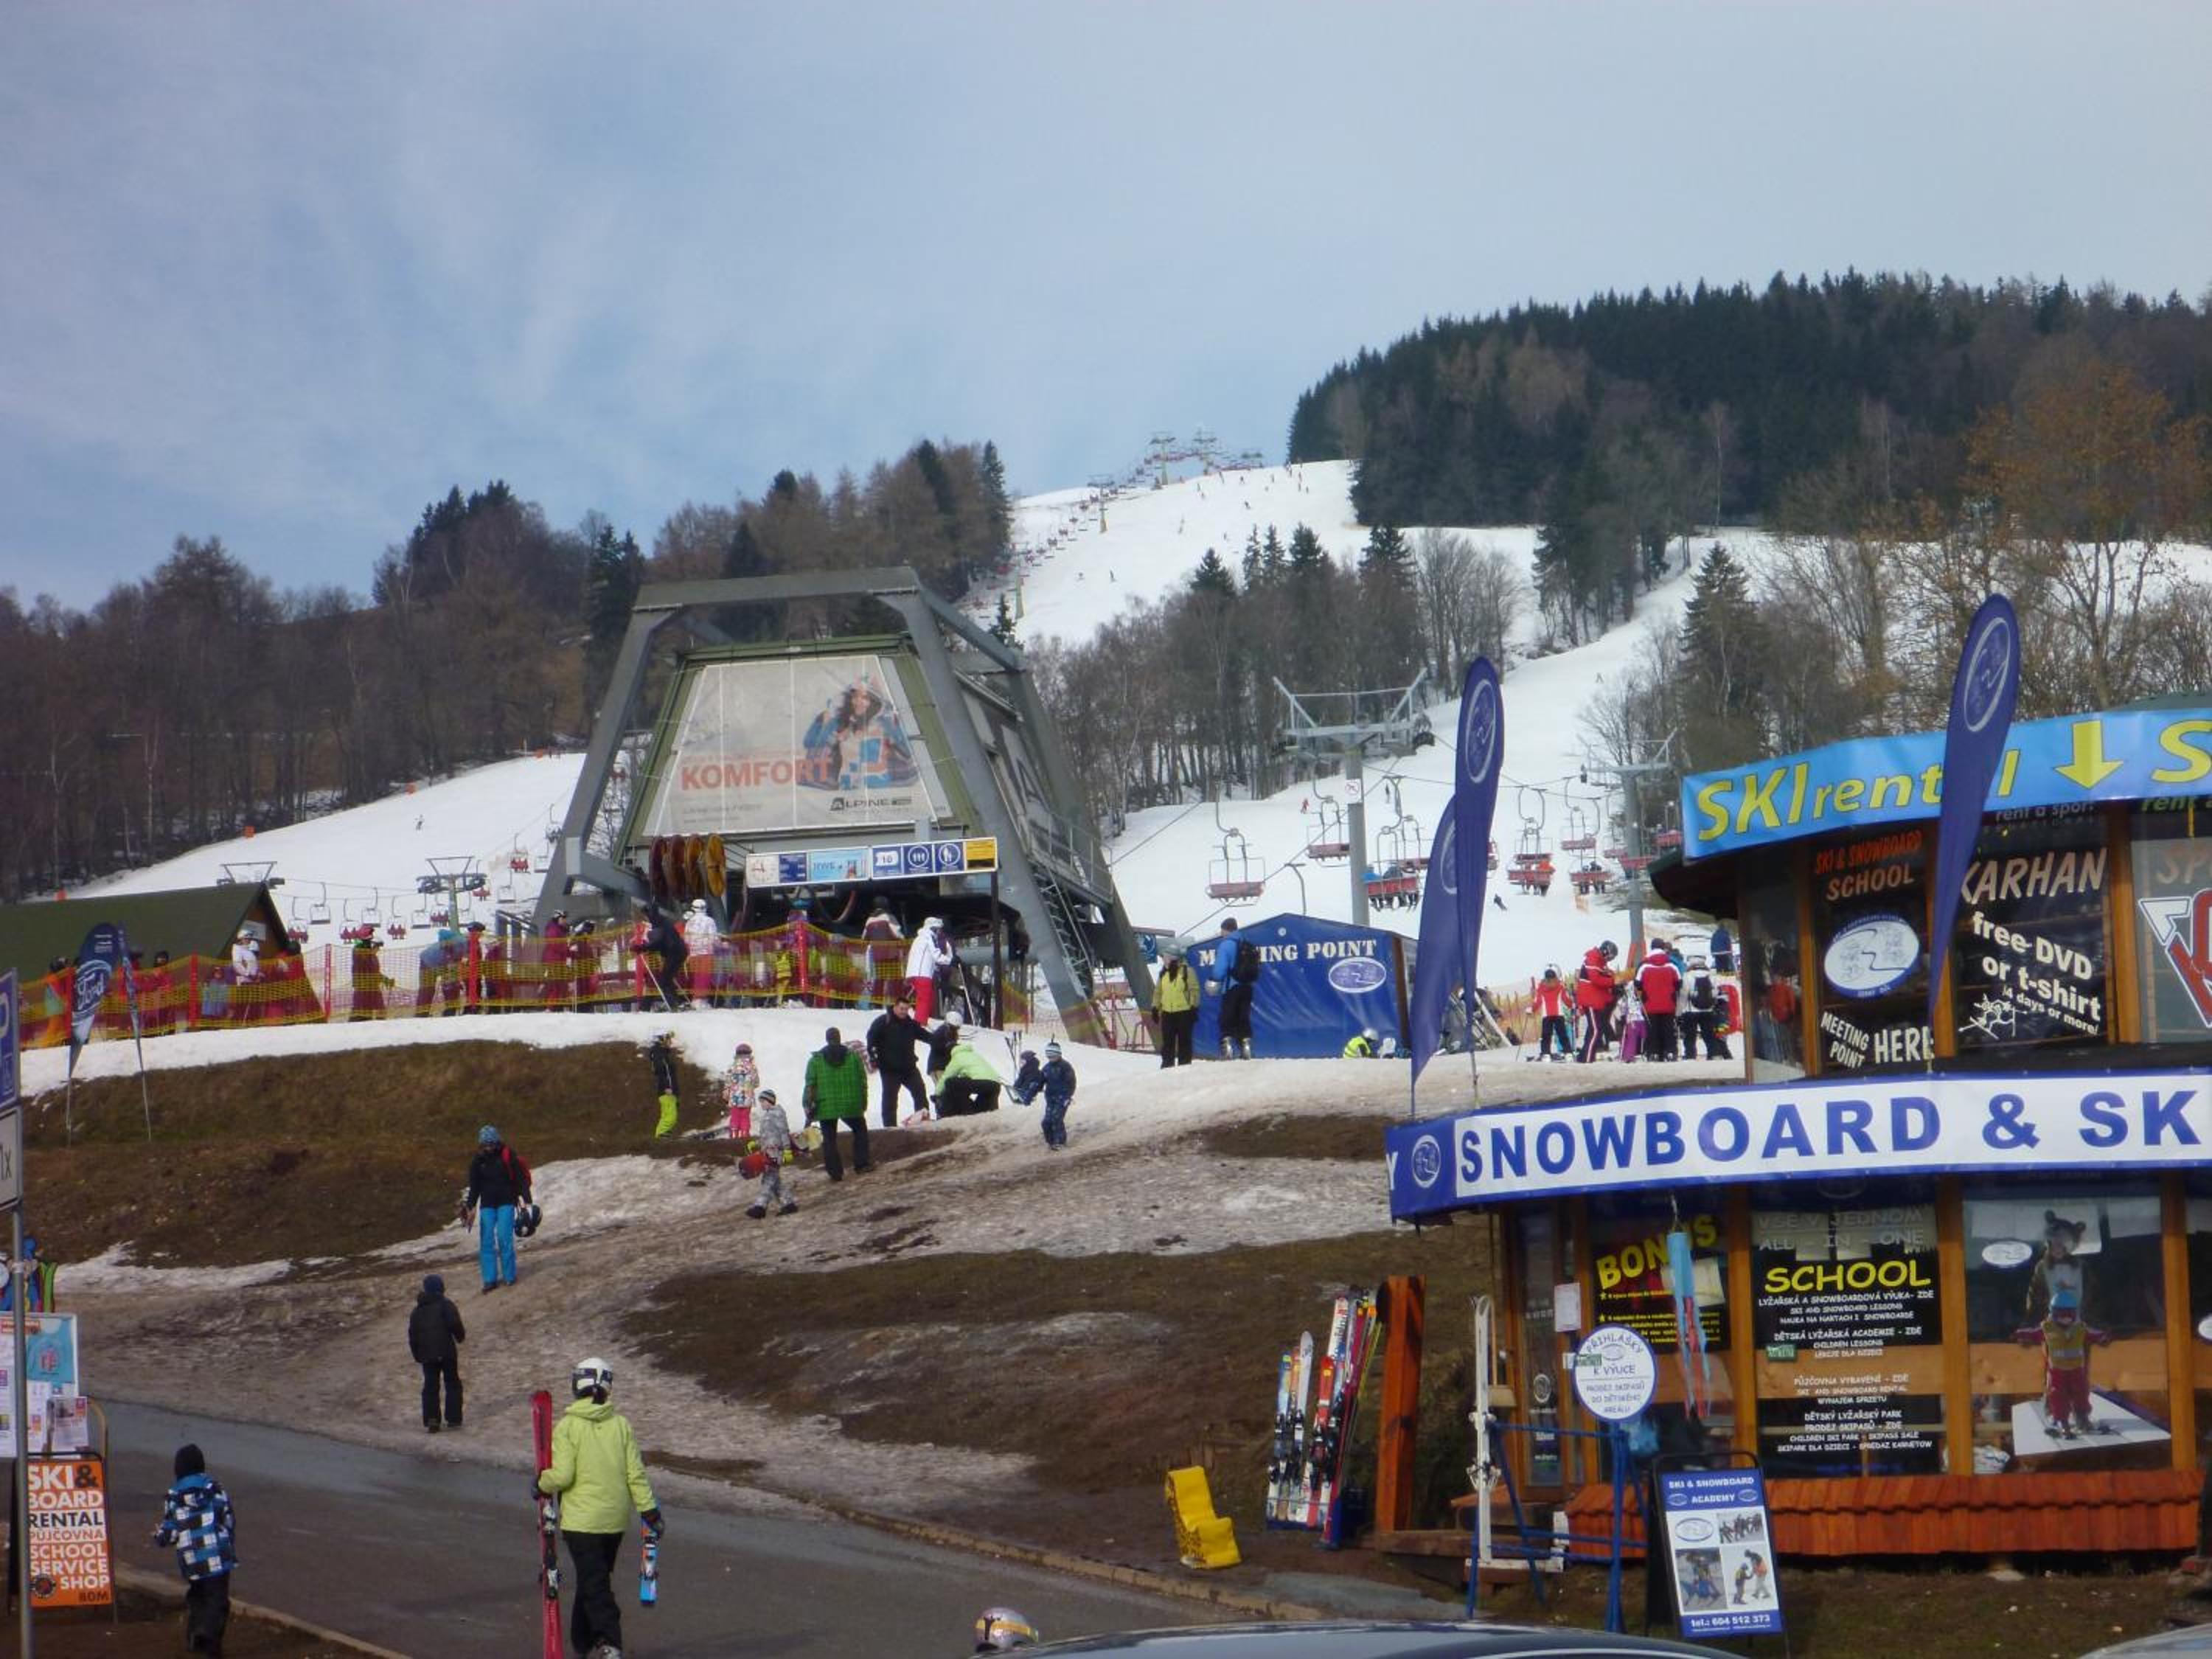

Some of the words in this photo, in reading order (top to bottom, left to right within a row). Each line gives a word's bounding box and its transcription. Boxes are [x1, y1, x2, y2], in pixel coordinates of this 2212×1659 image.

[681, 754, 832, 790] KOMFORT
[1698, 749, 2020, 841] SKIrentl
[1826, 863, 1915, 901] SCHOOL
[1199, 944, 1298, 967] MING
[1307, 939, 1377, 959] POINT
[2036, 936, 2093, 980] DVD
[1982, 956, 2011, 981] or
[2018, 966, 2101, 1021] t-shirt
[2017, 992, 2045, 1012] days
[2048, 1007, 2062, 1020] or
[1820, 1012, 1870, 1051] MEETING
[1829, 1040, 1865, 1068] POINT
[1461, 1096, 1941, 1183] SNOWBOARD
[1981, 1093, 2041, 1150] &
[2079, 1090, 2202, 1148] SK
[1596, 1215, 1717, 1290] BONS
[1764, 1259, 1932, 1293] SCHOOL
[1823, 1304, 1868, 1313] SNOWBOARD
[1870, 1303, 1904, 1311] LESSONS
[27, 1465, 74, 1490] SKI
[75, 1464, 100, 1488] &
[1669, 1481, 1685, 1489] SKI
[1696, 1477, 1755, 1488] SNOWBOARD
[1691, 1494, 1736, 1504] ACADEMY
[29, 1512, 103, 1528] RENTAL
[30, 1543, 107, 1559] SCHOOL
[30, 1559, 108, 1576] SERVICE
[60, 1575, 110, 1590] SHOP
